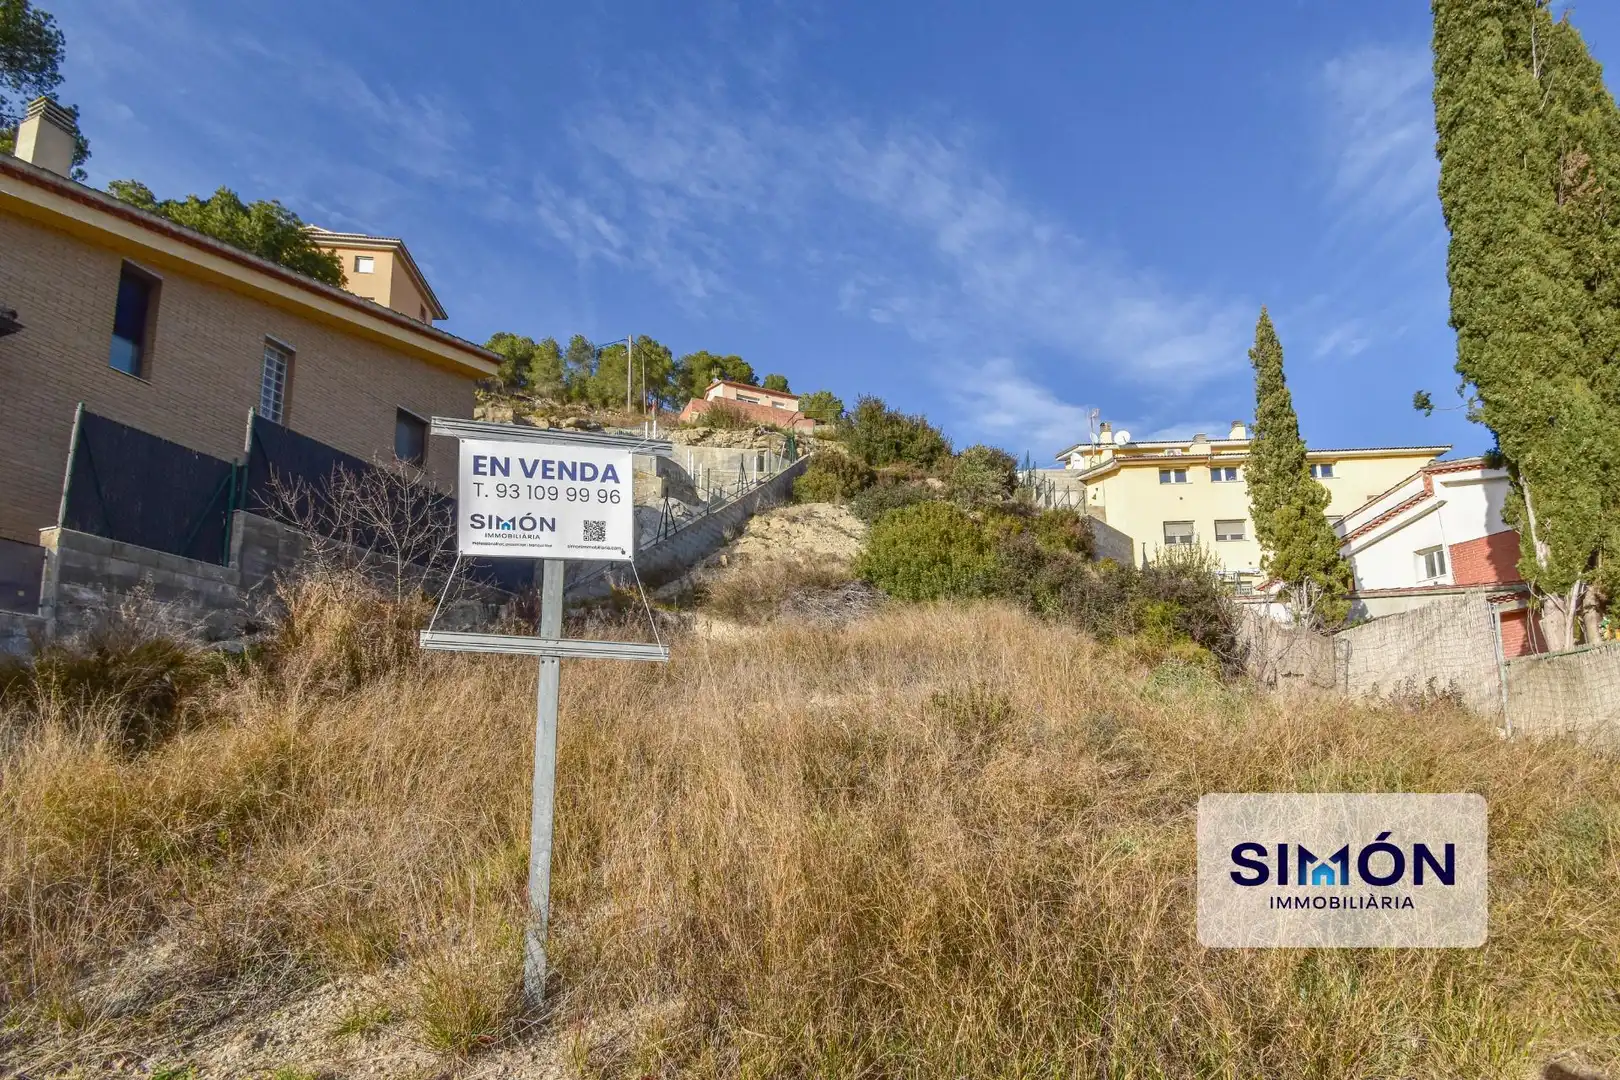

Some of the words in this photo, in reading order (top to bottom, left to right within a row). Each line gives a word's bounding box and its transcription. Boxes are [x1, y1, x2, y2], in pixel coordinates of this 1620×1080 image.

[473, 455, 510, 477] EN
[518, 458, 620, 484] VENDA
[473, 482, 488, 498] T.
[496, 483, 520, 499] 93
[527, 485, 558, 501] 109
[566, 487, 590, 502] 99
[597, 489, 621, 504] 96
[470, 512, 556, 532] SIMÓN
